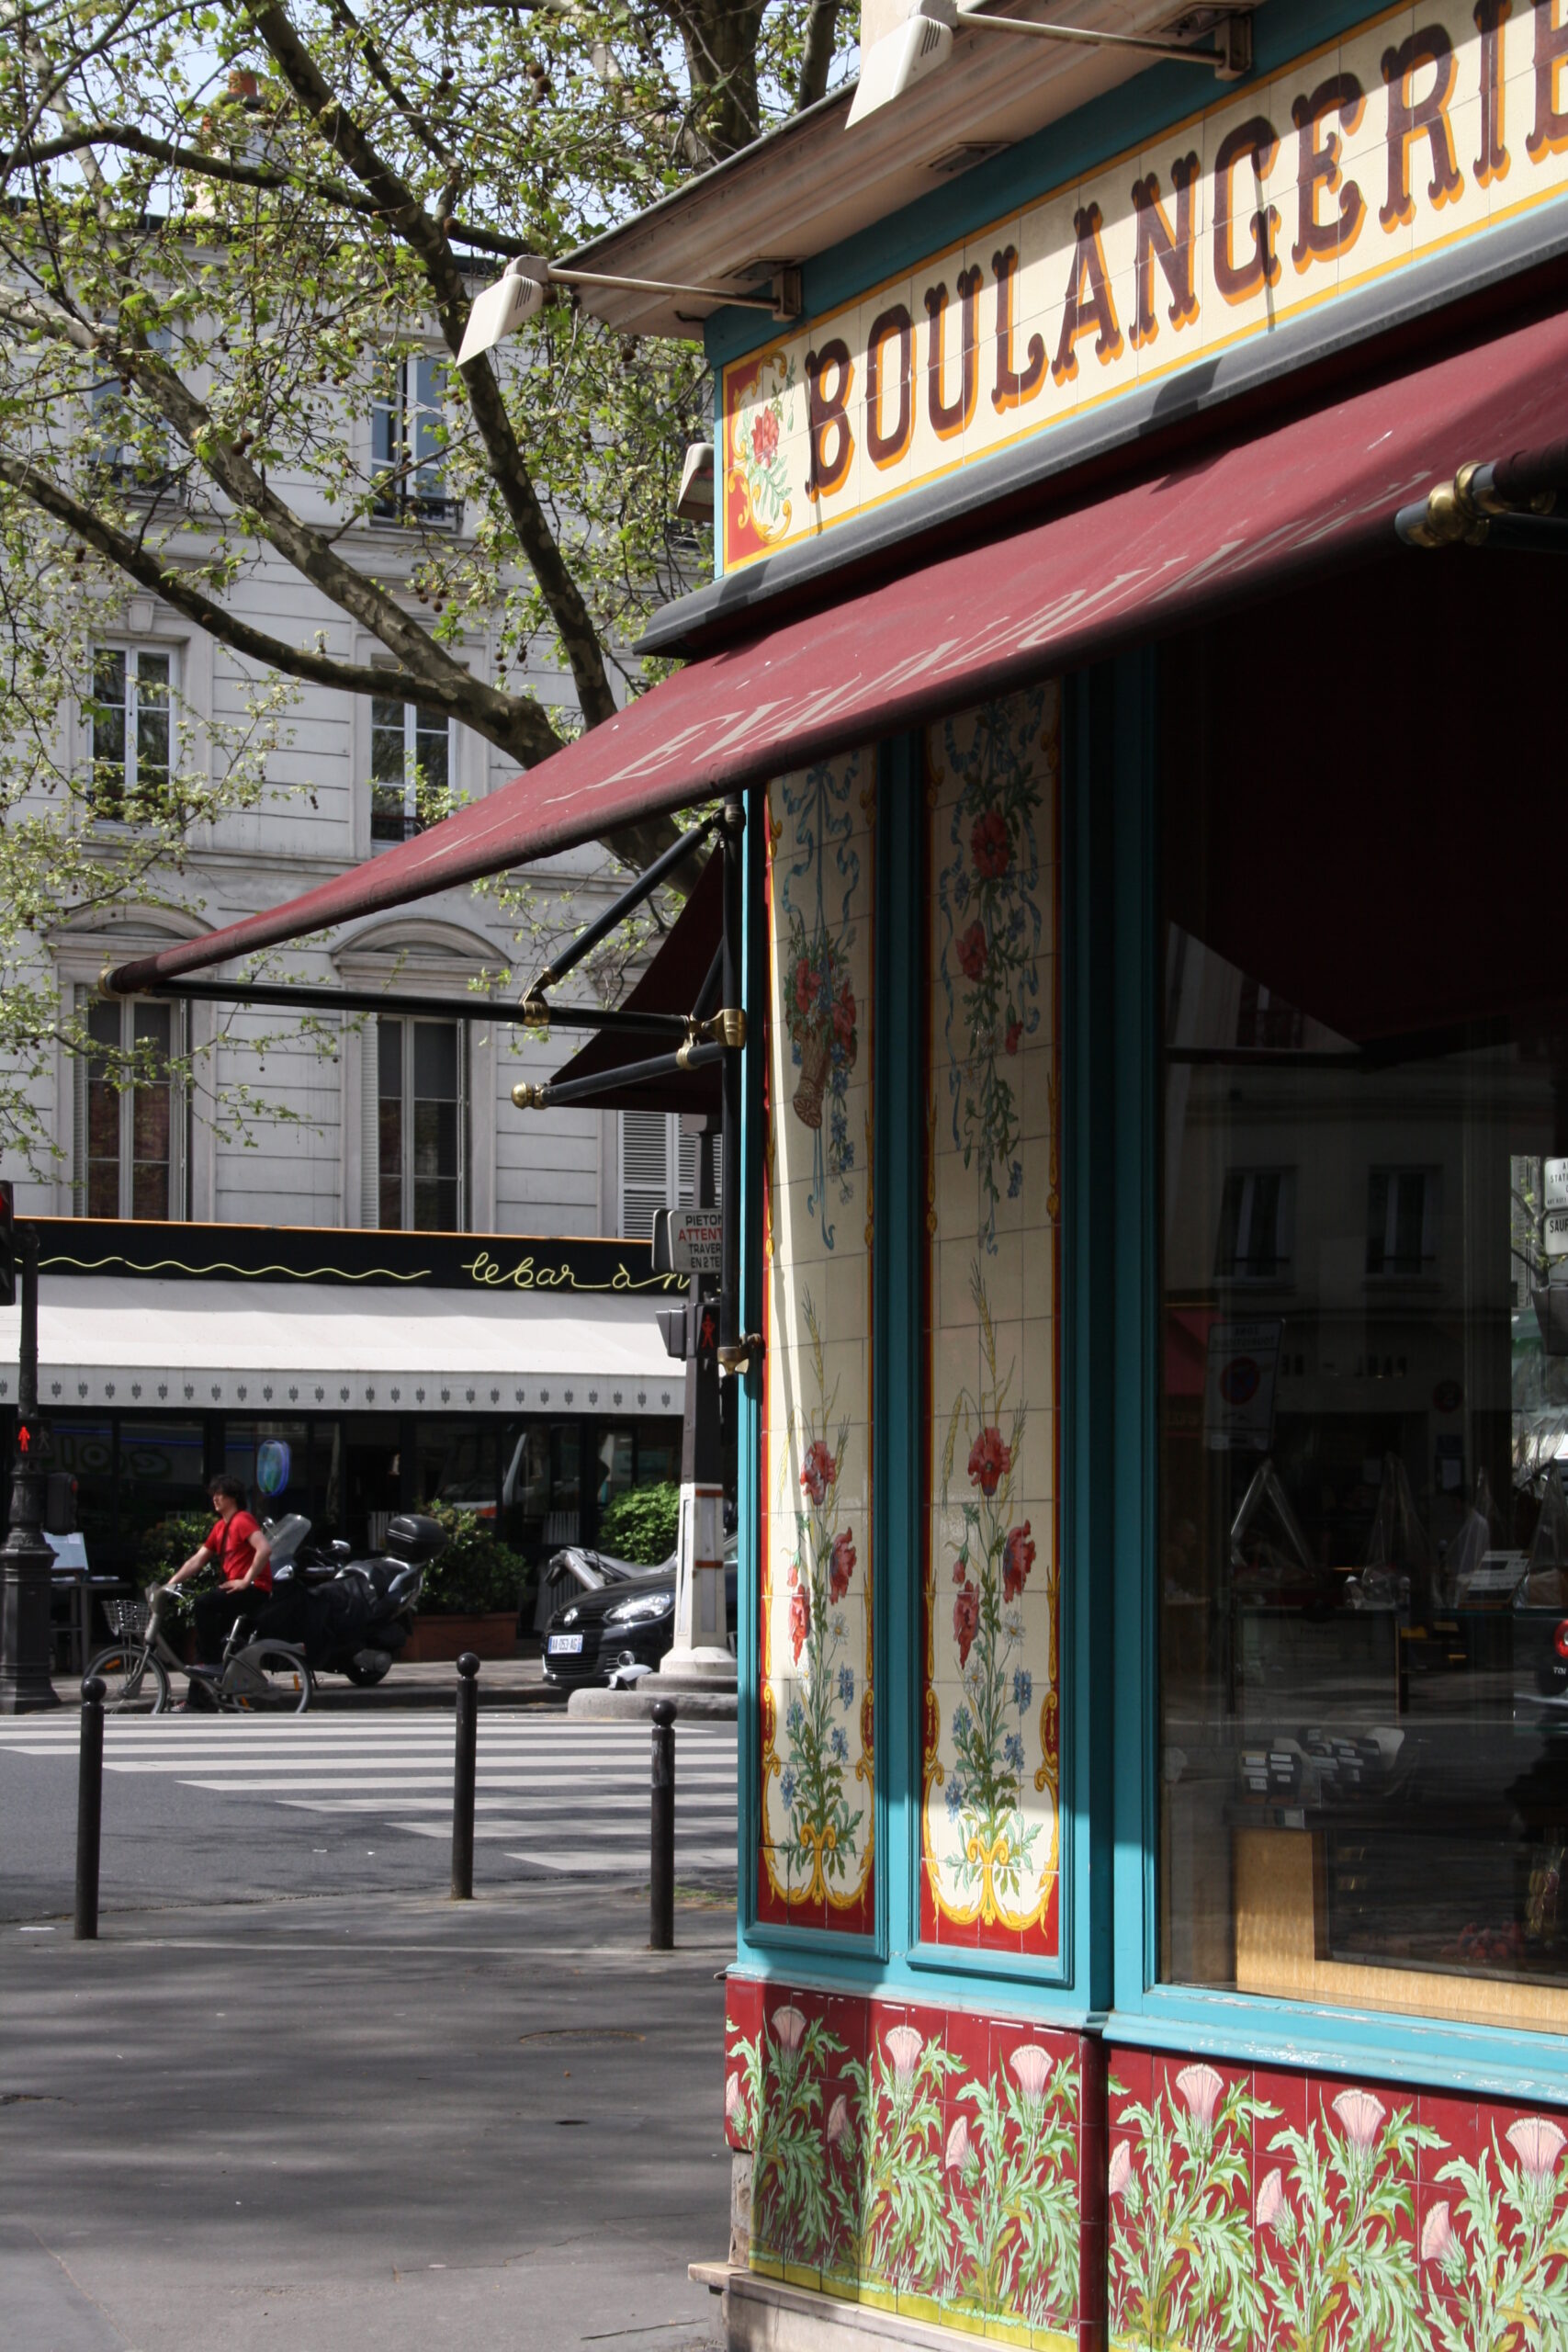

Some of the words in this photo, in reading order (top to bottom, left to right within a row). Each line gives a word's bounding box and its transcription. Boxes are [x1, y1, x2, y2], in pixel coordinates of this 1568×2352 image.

[691, 1257, 703, 1268] EN
[703, 1257, 710, 1268] 2
[711, 1257, 722, 1268] TE
